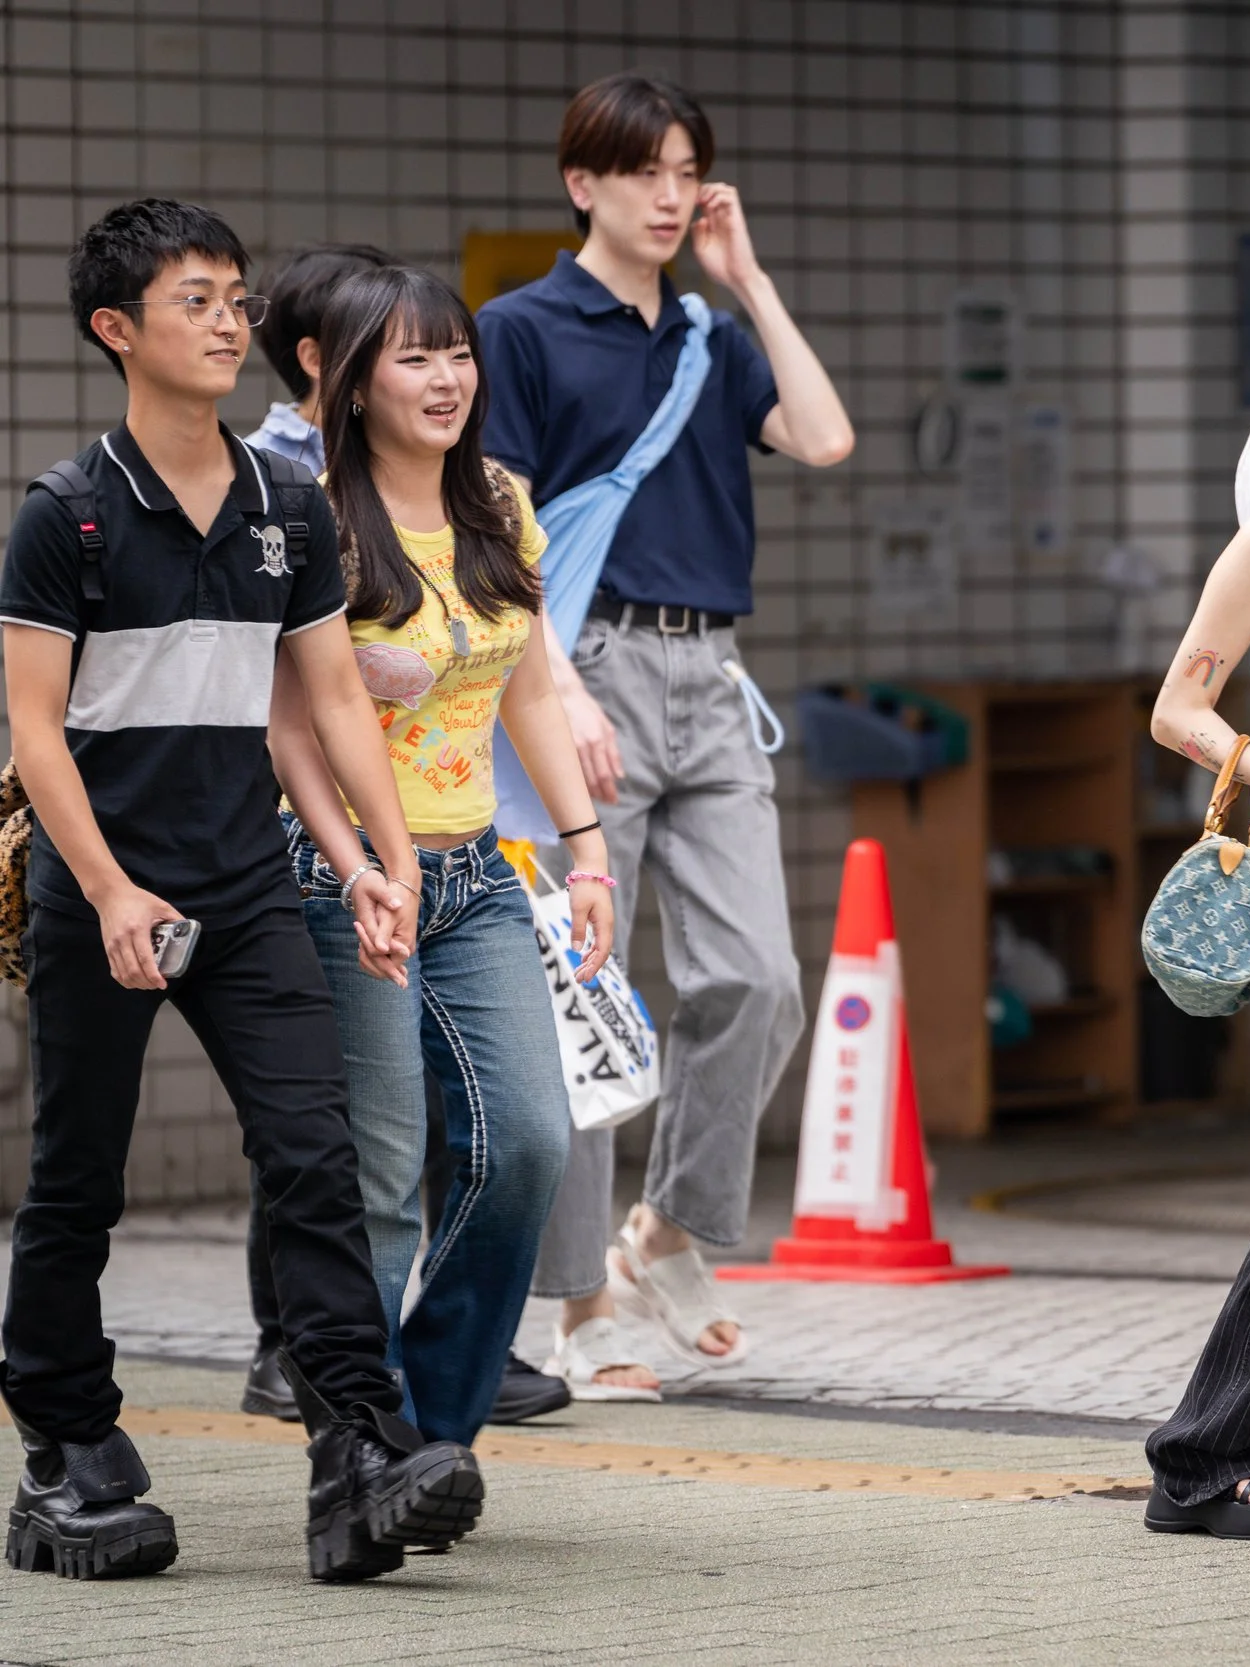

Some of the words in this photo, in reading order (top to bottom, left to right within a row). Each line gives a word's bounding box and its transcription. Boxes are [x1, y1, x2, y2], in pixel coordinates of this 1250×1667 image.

[445, 693, 474, 711] New
[412, 762, 423, 774] a
[422, 767, 448, 794] Chat
